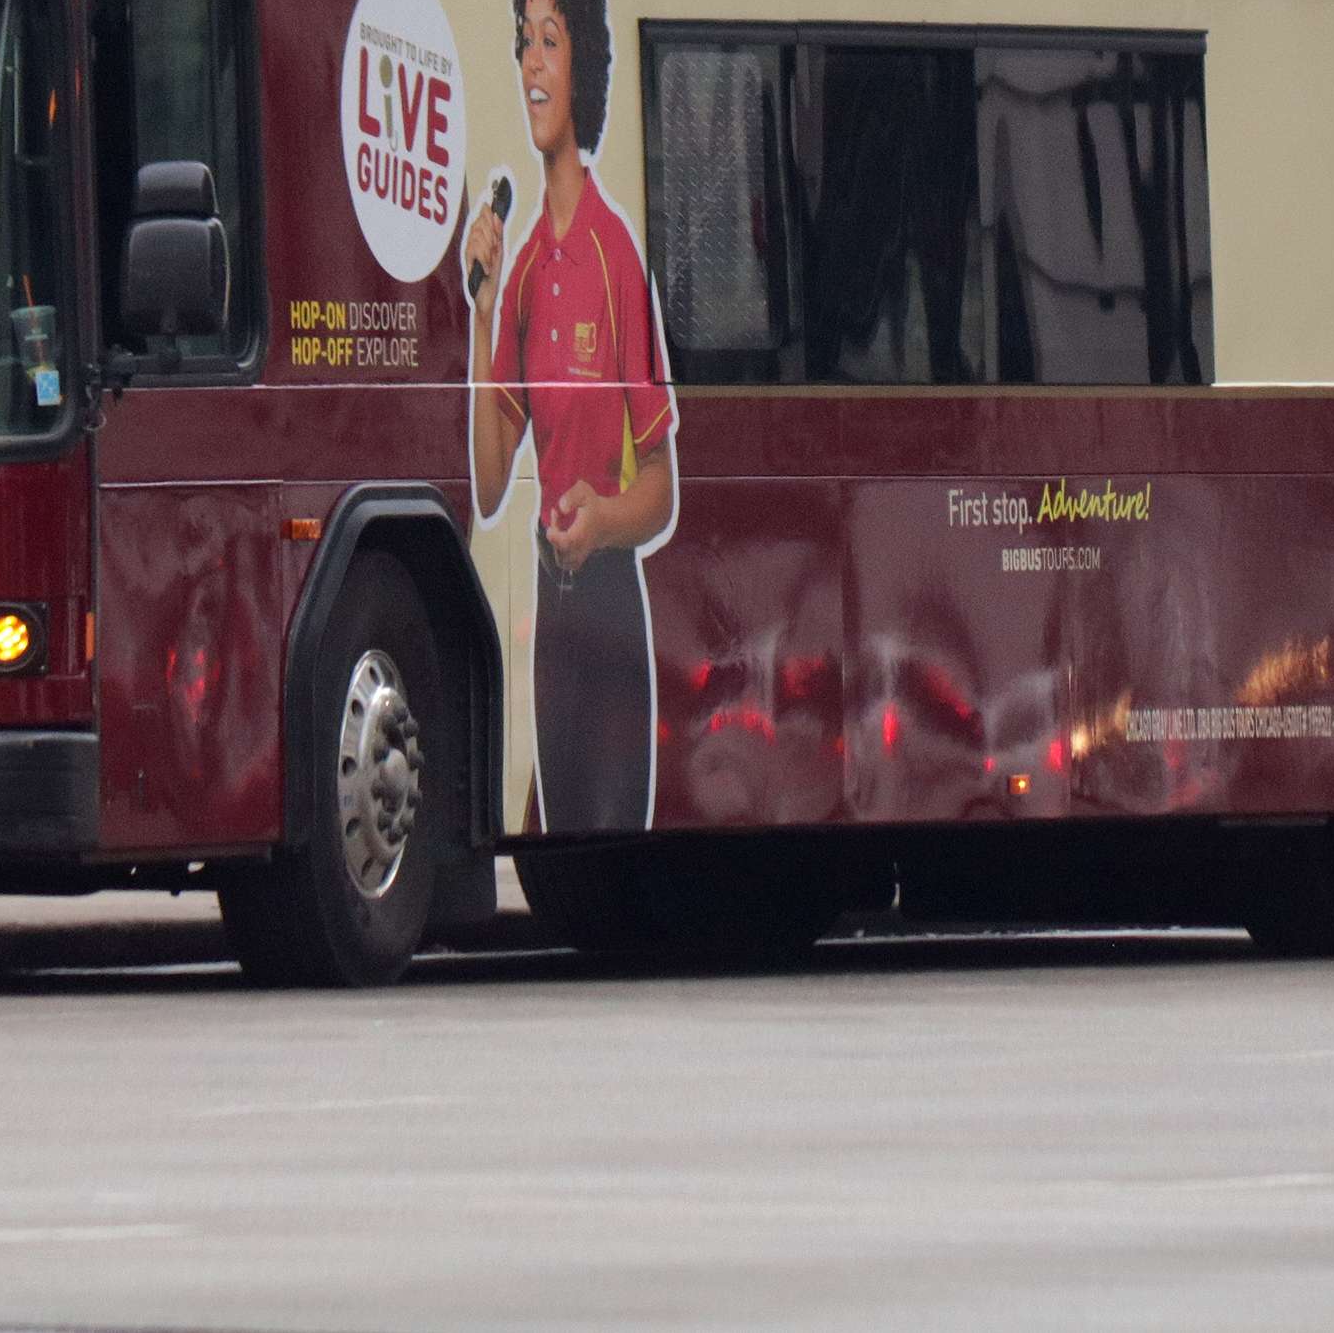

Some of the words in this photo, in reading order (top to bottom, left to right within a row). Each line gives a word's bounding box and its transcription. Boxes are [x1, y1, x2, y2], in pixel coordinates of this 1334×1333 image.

[356, 142, 449, 227] GUIDES
[290, 300, 346, 330] HOP-ON
[349, 301, 417, 332] DISCOVER
[291, 336, 353, 366] HOP-OFF
[356, 337, 419, 367] EXPLORE
[948, 488, 989, 528] First
[993, 491, 1033, 534] stop.
[1036, 477, 1151, 523] Adventure!
[1002, 546, 1101, 571] BIGBUSTOURS.COM
